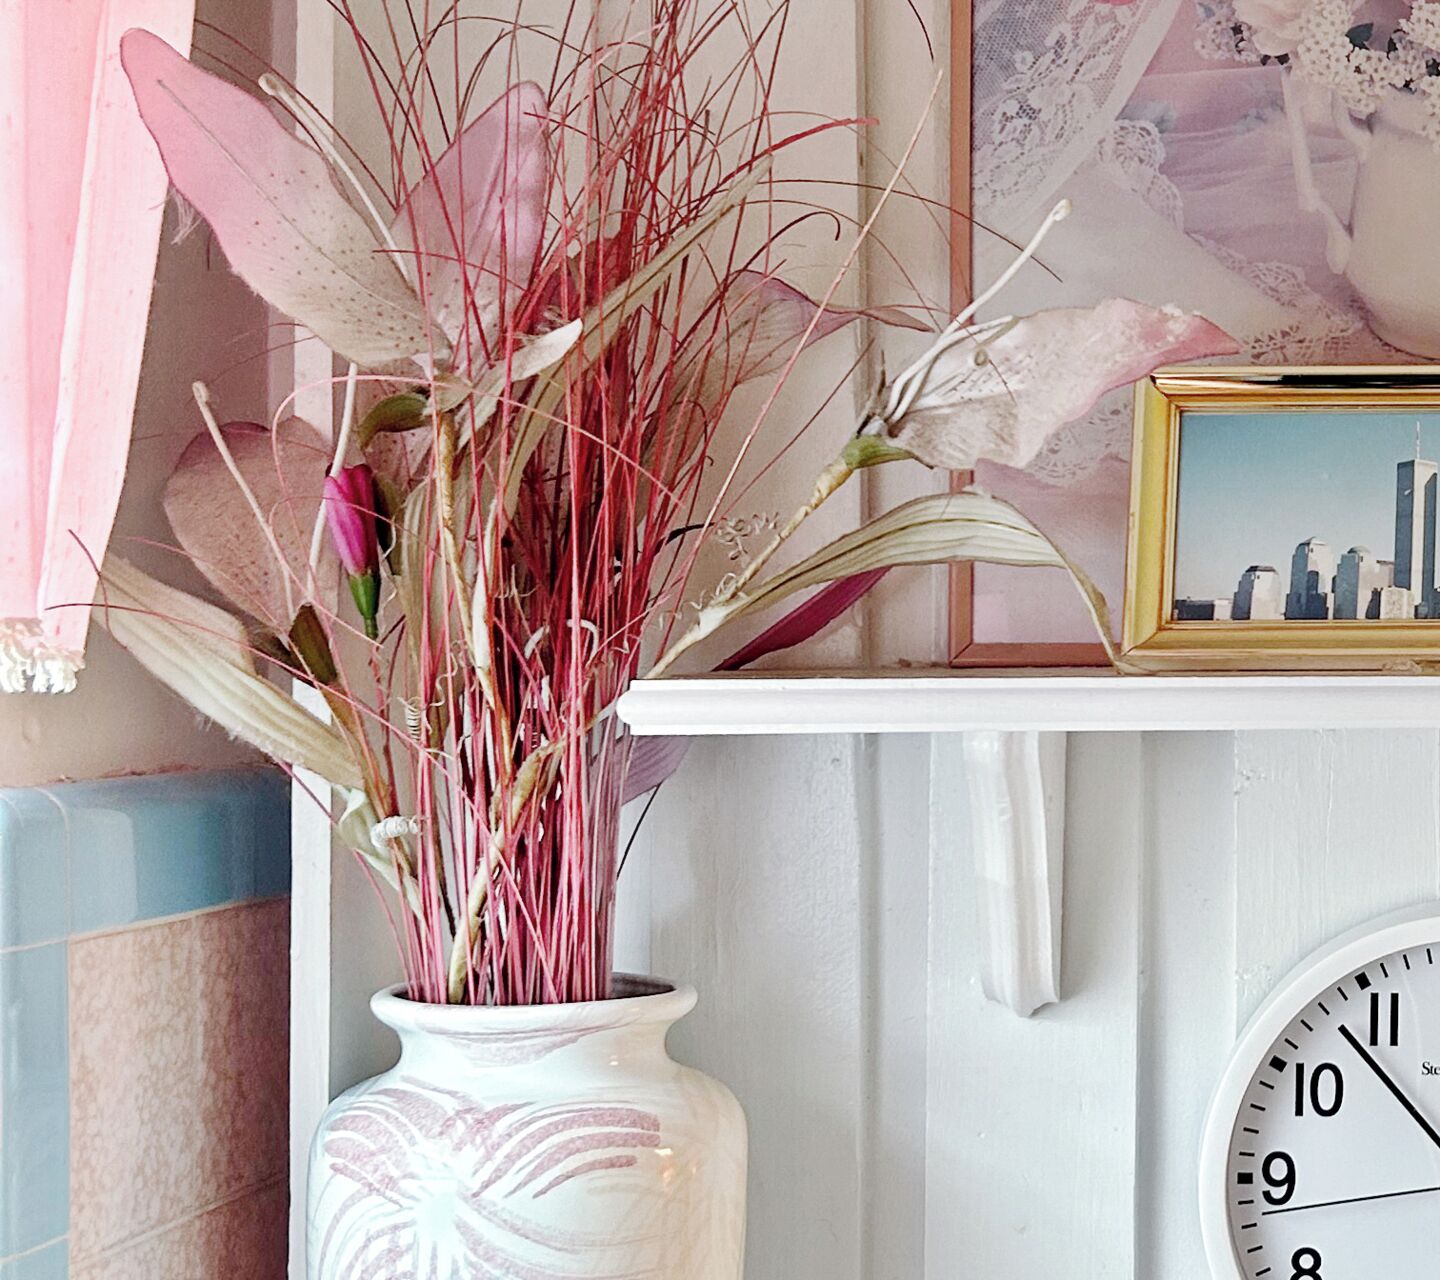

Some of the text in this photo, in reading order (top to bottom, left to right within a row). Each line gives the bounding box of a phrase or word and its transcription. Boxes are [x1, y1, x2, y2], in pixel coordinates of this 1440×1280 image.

[1369, 992, 1400, 1048] 11
[1294, 1061, 1345, 1118] 10
[1260, 1150, 1297, 1207] 9
